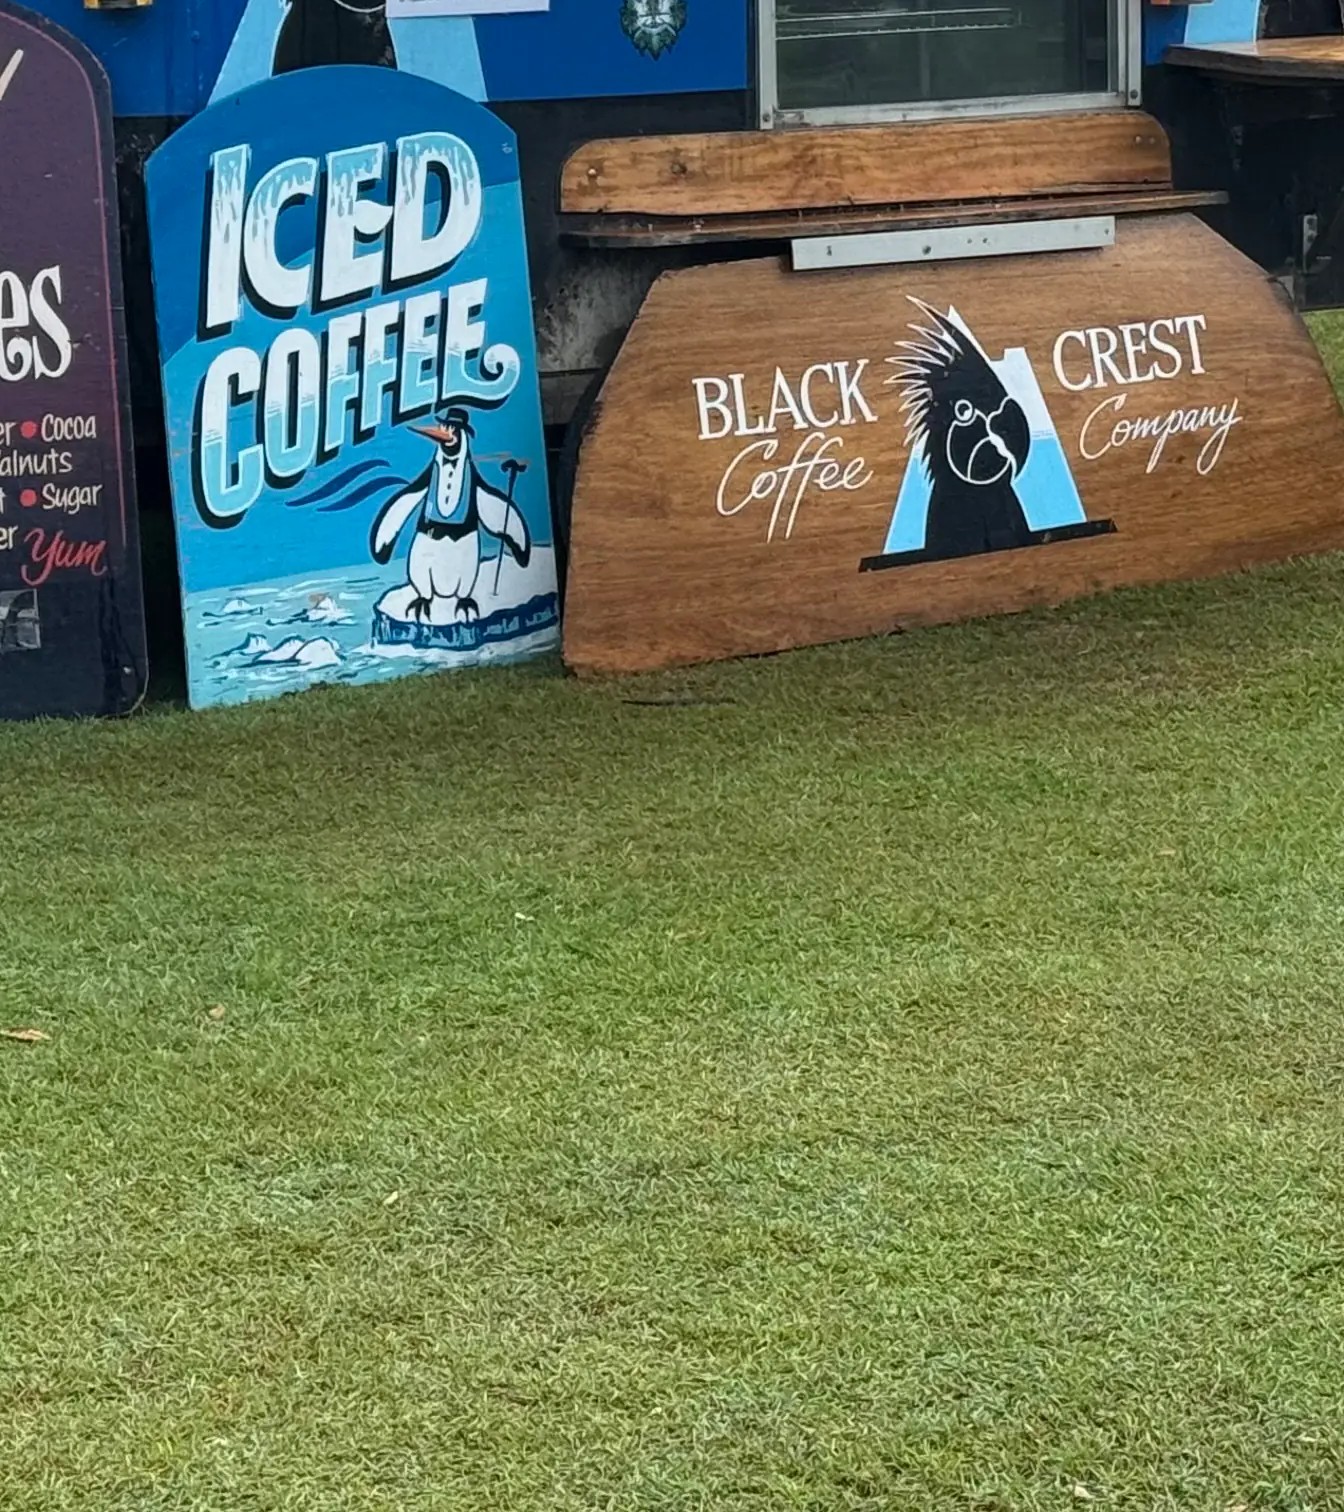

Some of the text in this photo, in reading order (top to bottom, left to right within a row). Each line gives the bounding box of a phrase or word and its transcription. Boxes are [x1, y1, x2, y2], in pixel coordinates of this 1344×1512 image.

[199, 130, 483, 334] ICED
[40, 414, 98, 441] Cocoa
[198, 276, 522, 522] COFFEE
[691, 313, 1209, 441] BLACK CREST
[41, 482, 103, 513] Sugar
[716, 392, 1244, 544] Coffee Company
[19, 526, 109, 587] Yum
